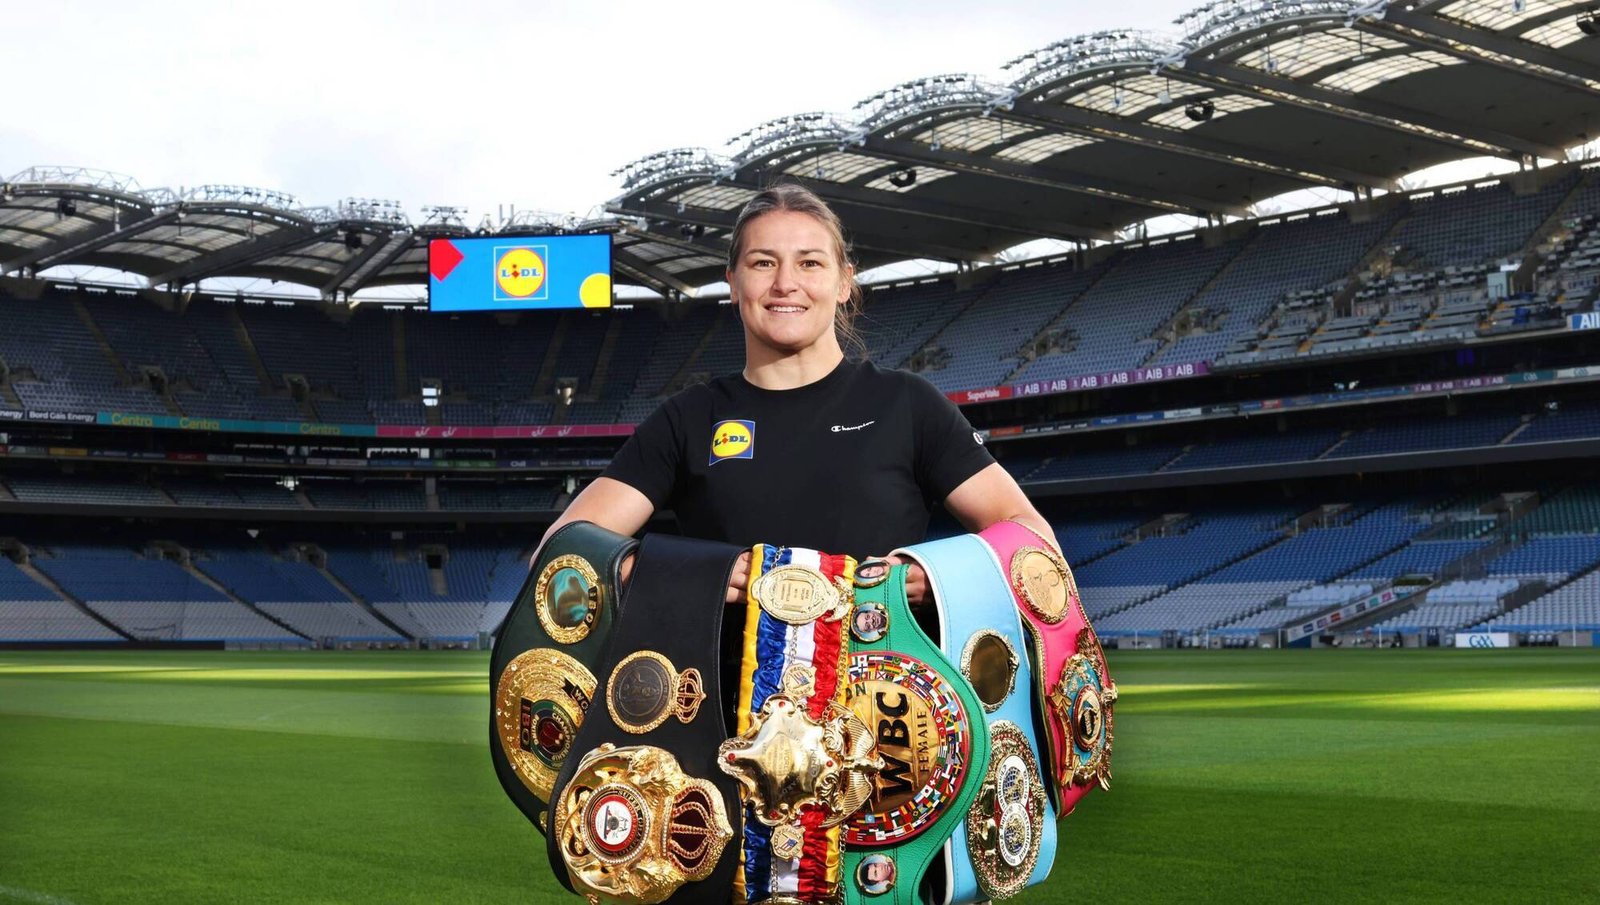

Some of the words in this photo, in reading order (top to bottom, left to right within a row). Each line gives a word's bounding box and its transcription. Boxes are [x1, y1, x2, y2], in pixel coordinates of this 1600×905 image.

[1024, 383, 1040, 394] AIB
[1051, 379, 1067, 391] AIB
[1080, 376, 1097, 388] AIB
[1111, 372, 1128, 384] AIB
[1145, 368, 1163, 380] AIB
[1176, 364, 1194, 376] AIB
[29, 411, 48, 419] Bord
[67, 413, 95, 423] Energy
[831, 420, 875, 433] Champion
[876, 692, 914, 796] WBC
[916, 710, 928, 773] FEMALE
